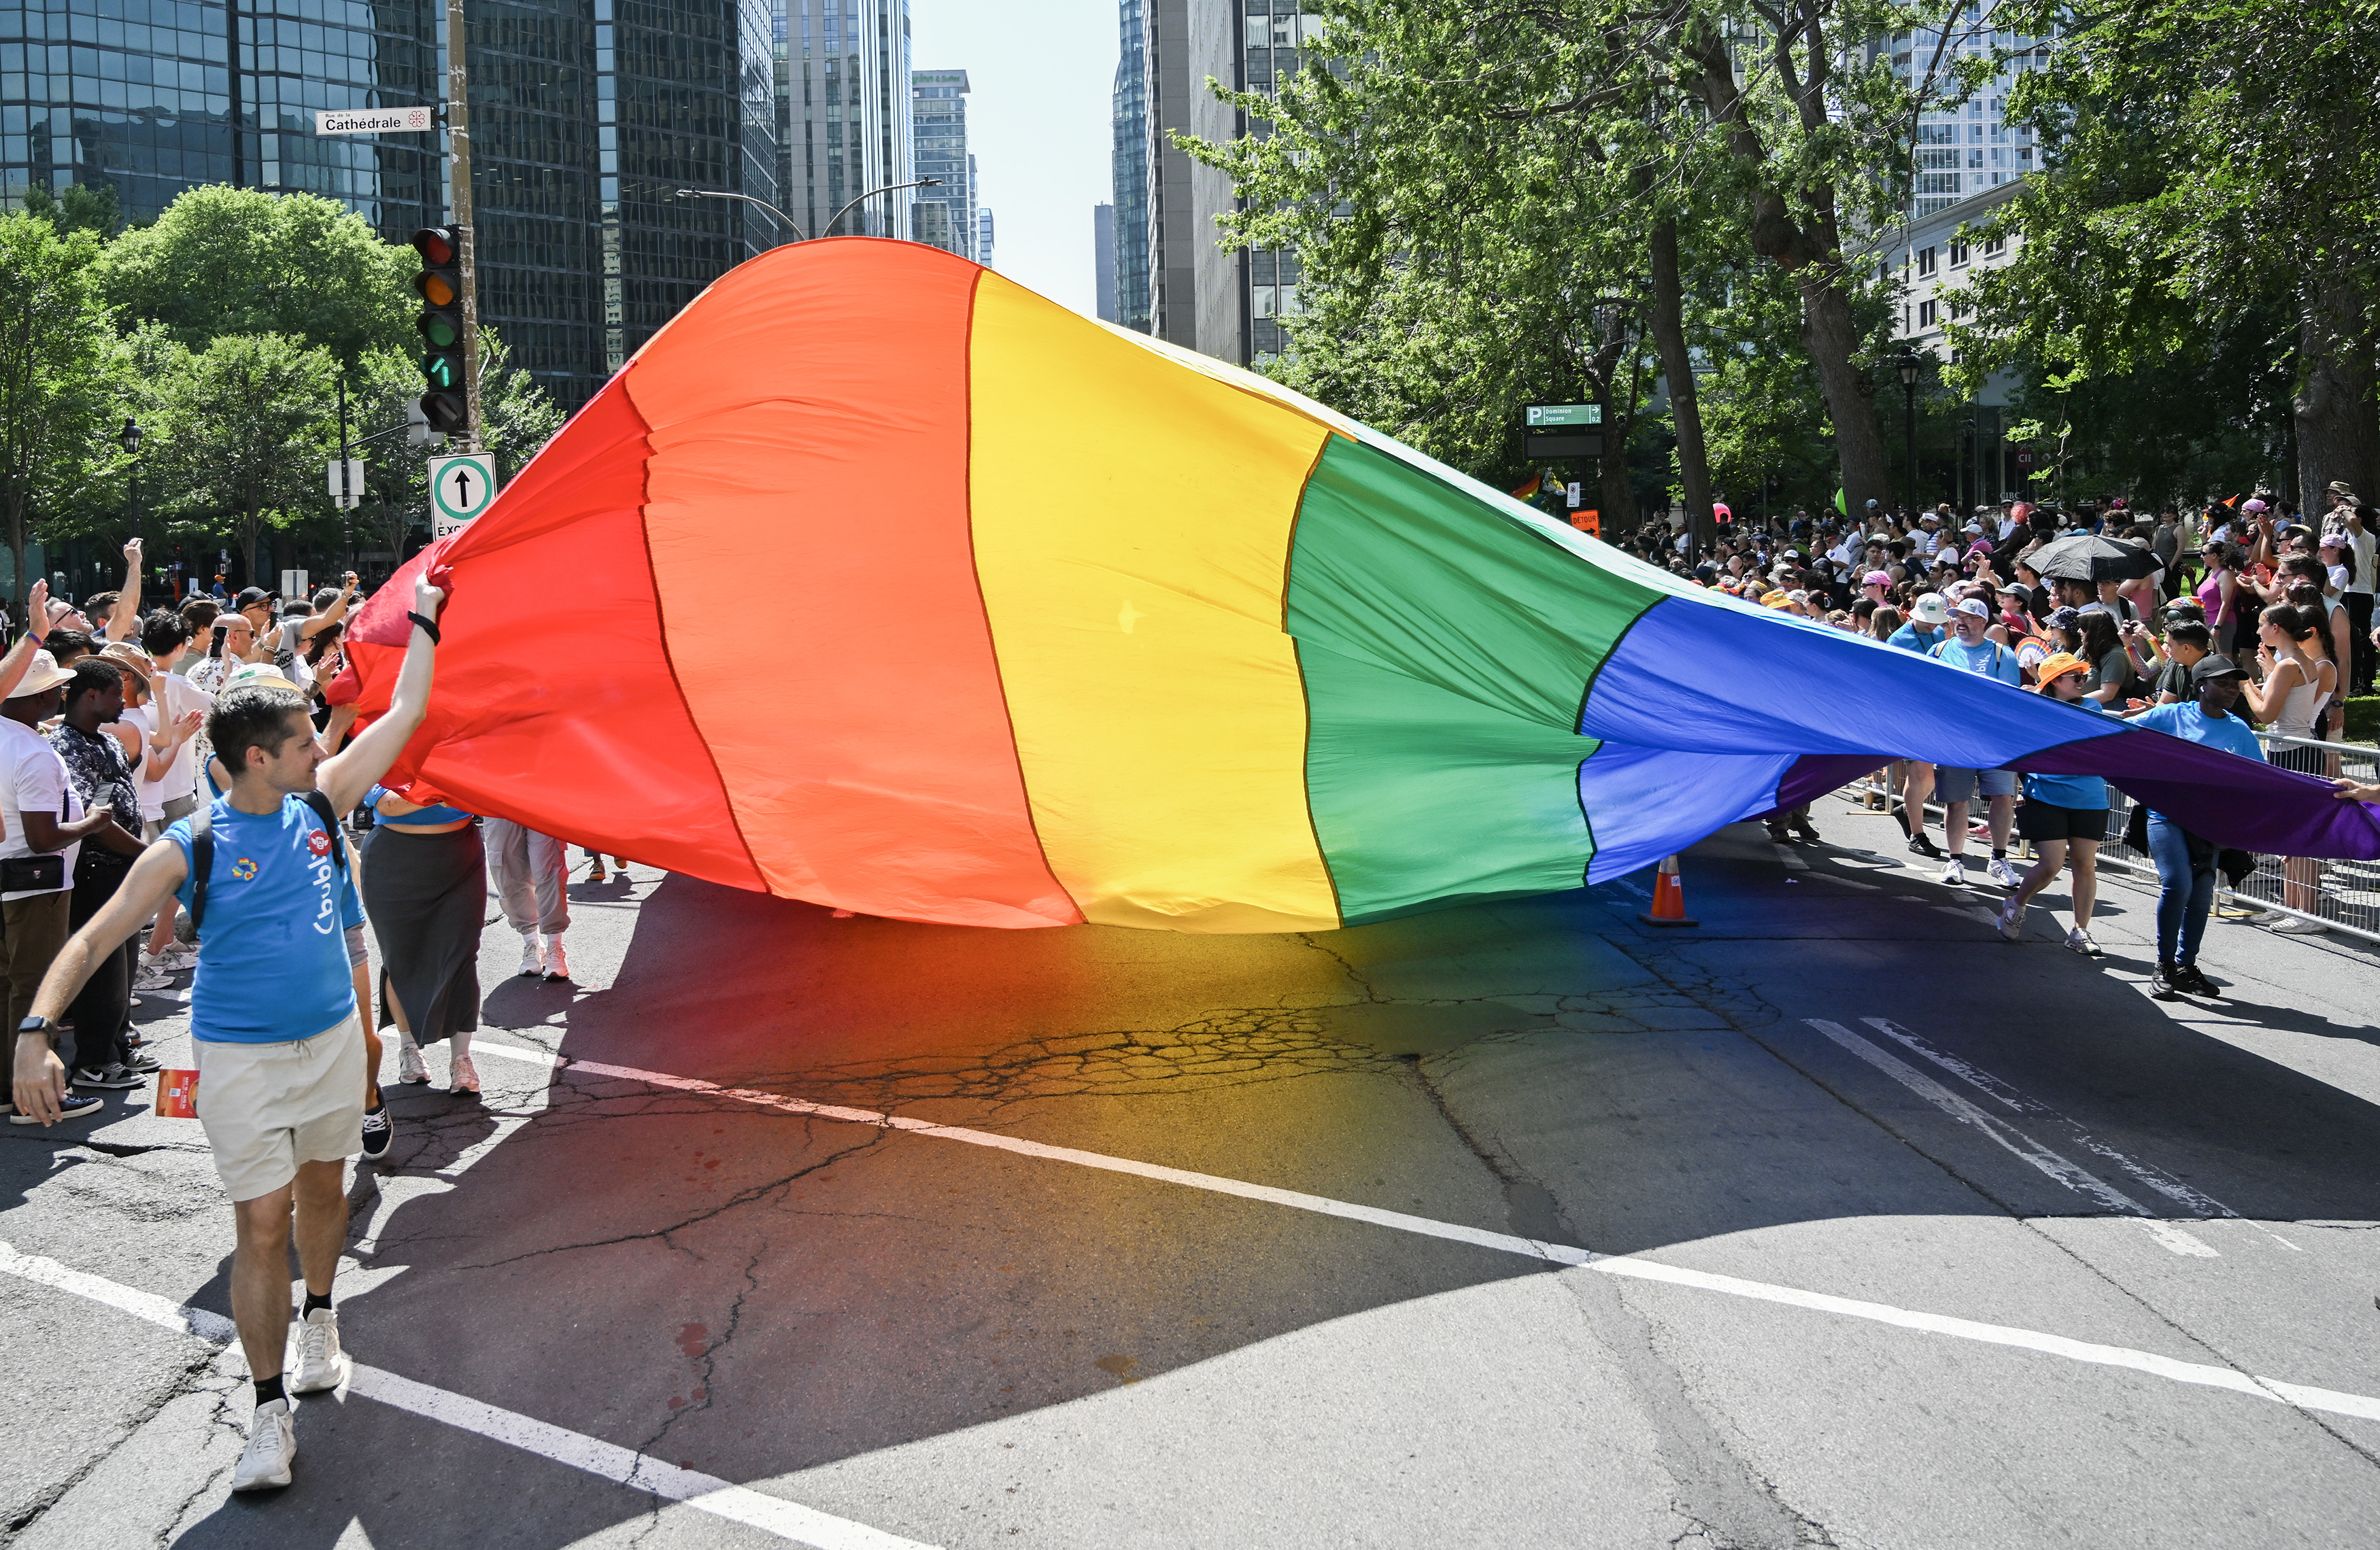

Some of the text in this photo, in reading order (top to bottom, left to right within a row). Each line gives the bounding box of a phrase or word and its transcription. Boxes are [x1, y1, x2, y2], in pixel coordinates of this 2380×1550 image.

[326, 117, 401, 131] Cathédrale
[1529, 408, 1542, 424] P
[1999, 492, 2020, 500] CIBC
[1573, 515, 1597, 524] DÉTOUR
